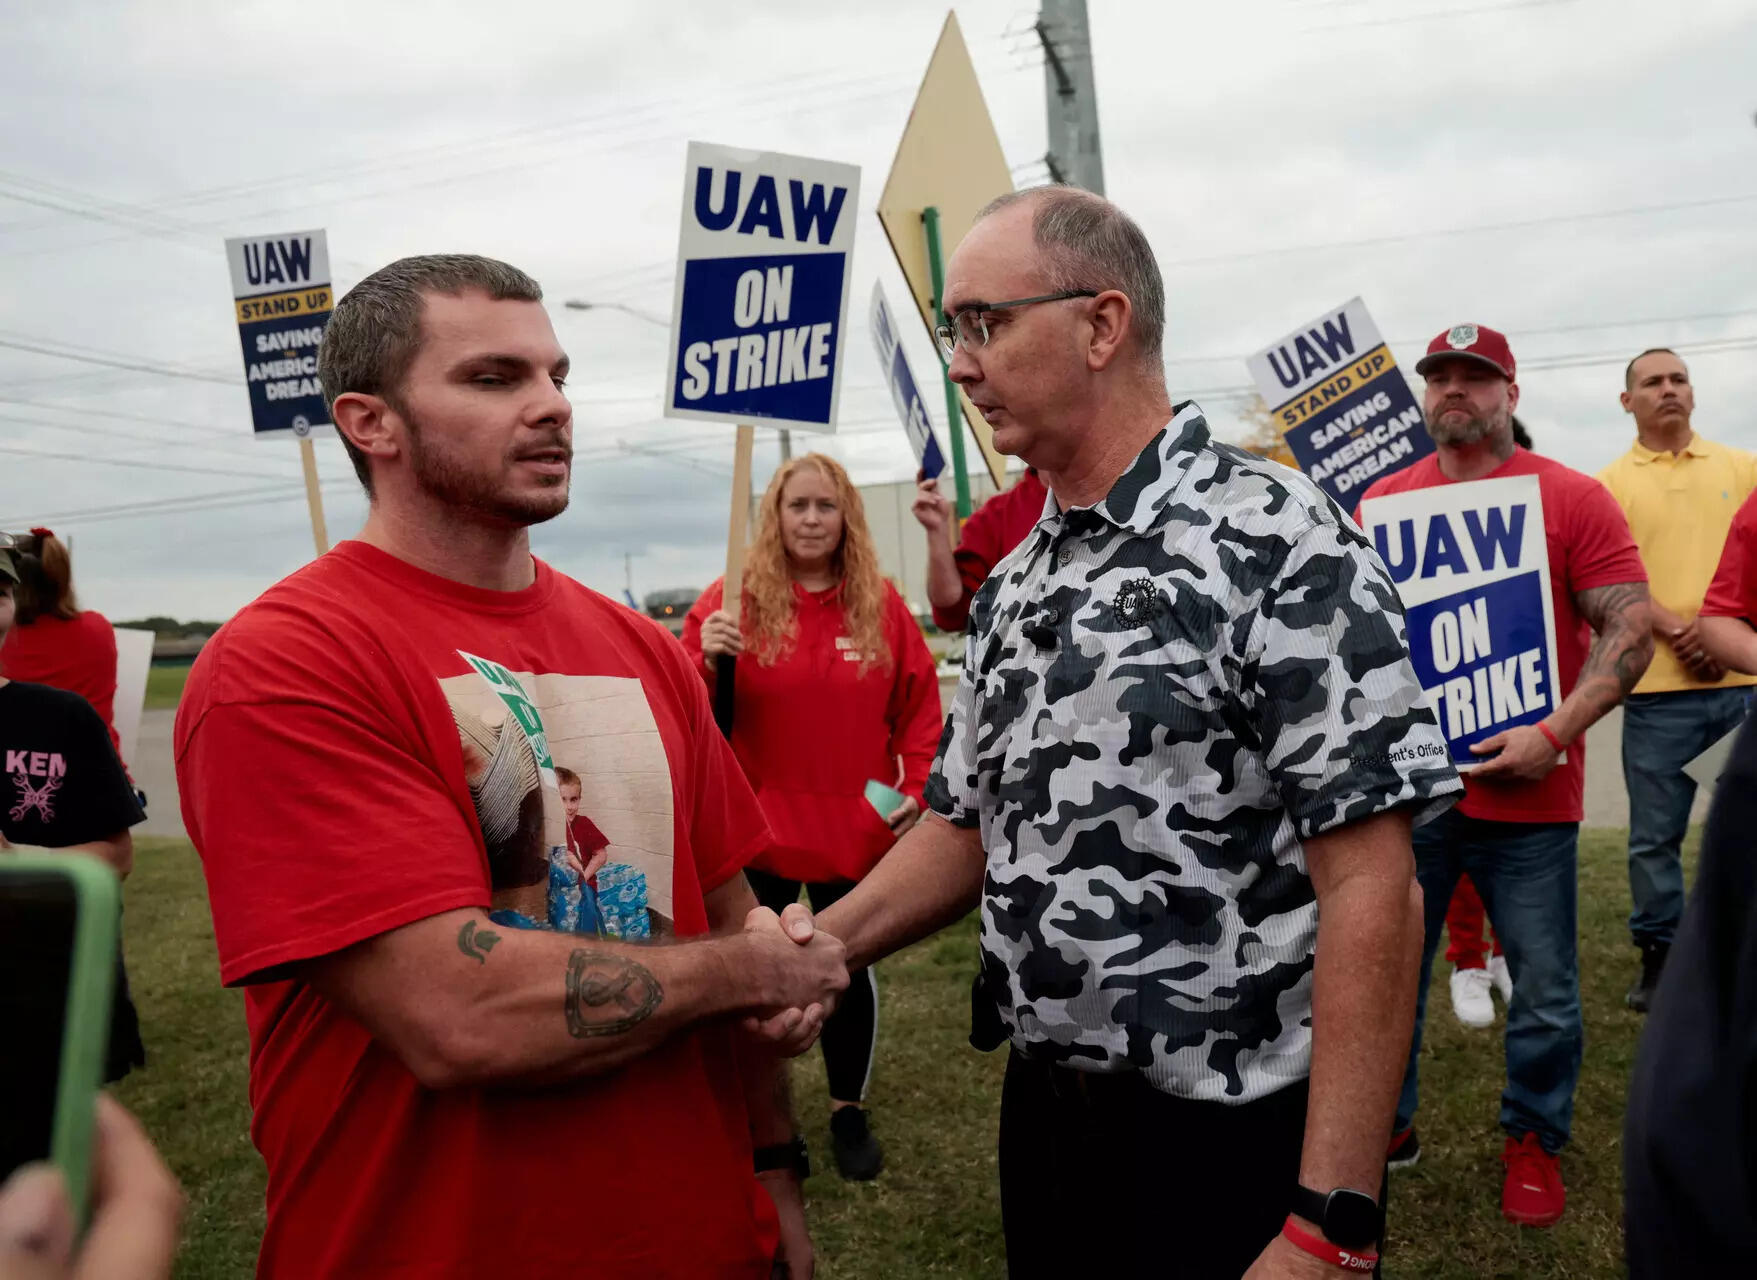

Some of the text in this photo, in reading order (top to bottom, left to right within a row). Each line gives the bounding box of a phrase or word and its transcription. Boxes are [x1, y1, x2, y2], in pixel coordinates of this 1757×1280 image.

[694, 166, 848, 245] UAW
[244, 238, 311, 285] UAW
[242, 292, 328, 319] STAND UP
[734, 265, 794, 329] ON
[249, 356, 319, 382] AMERIC
[256, 327, 323, 353] SAVING
[682, 322, 832, 401] STRIKE
[1266, 312, 1355, 389] UAW
[1283, 354, 1385, 426] STAND UP
[1310, 391, 1392, 450] SAVING
[1310, 405, 1422, 484] AMERICAN
[1334, 436, 1414, 494] DREAM
[1374, 504, 1526, 584] UAW
[1430, 597, 1492, 674] ON
[1423, 647, 1546, 741] TRIKE
[1417, 742, 1444, 757] Office
